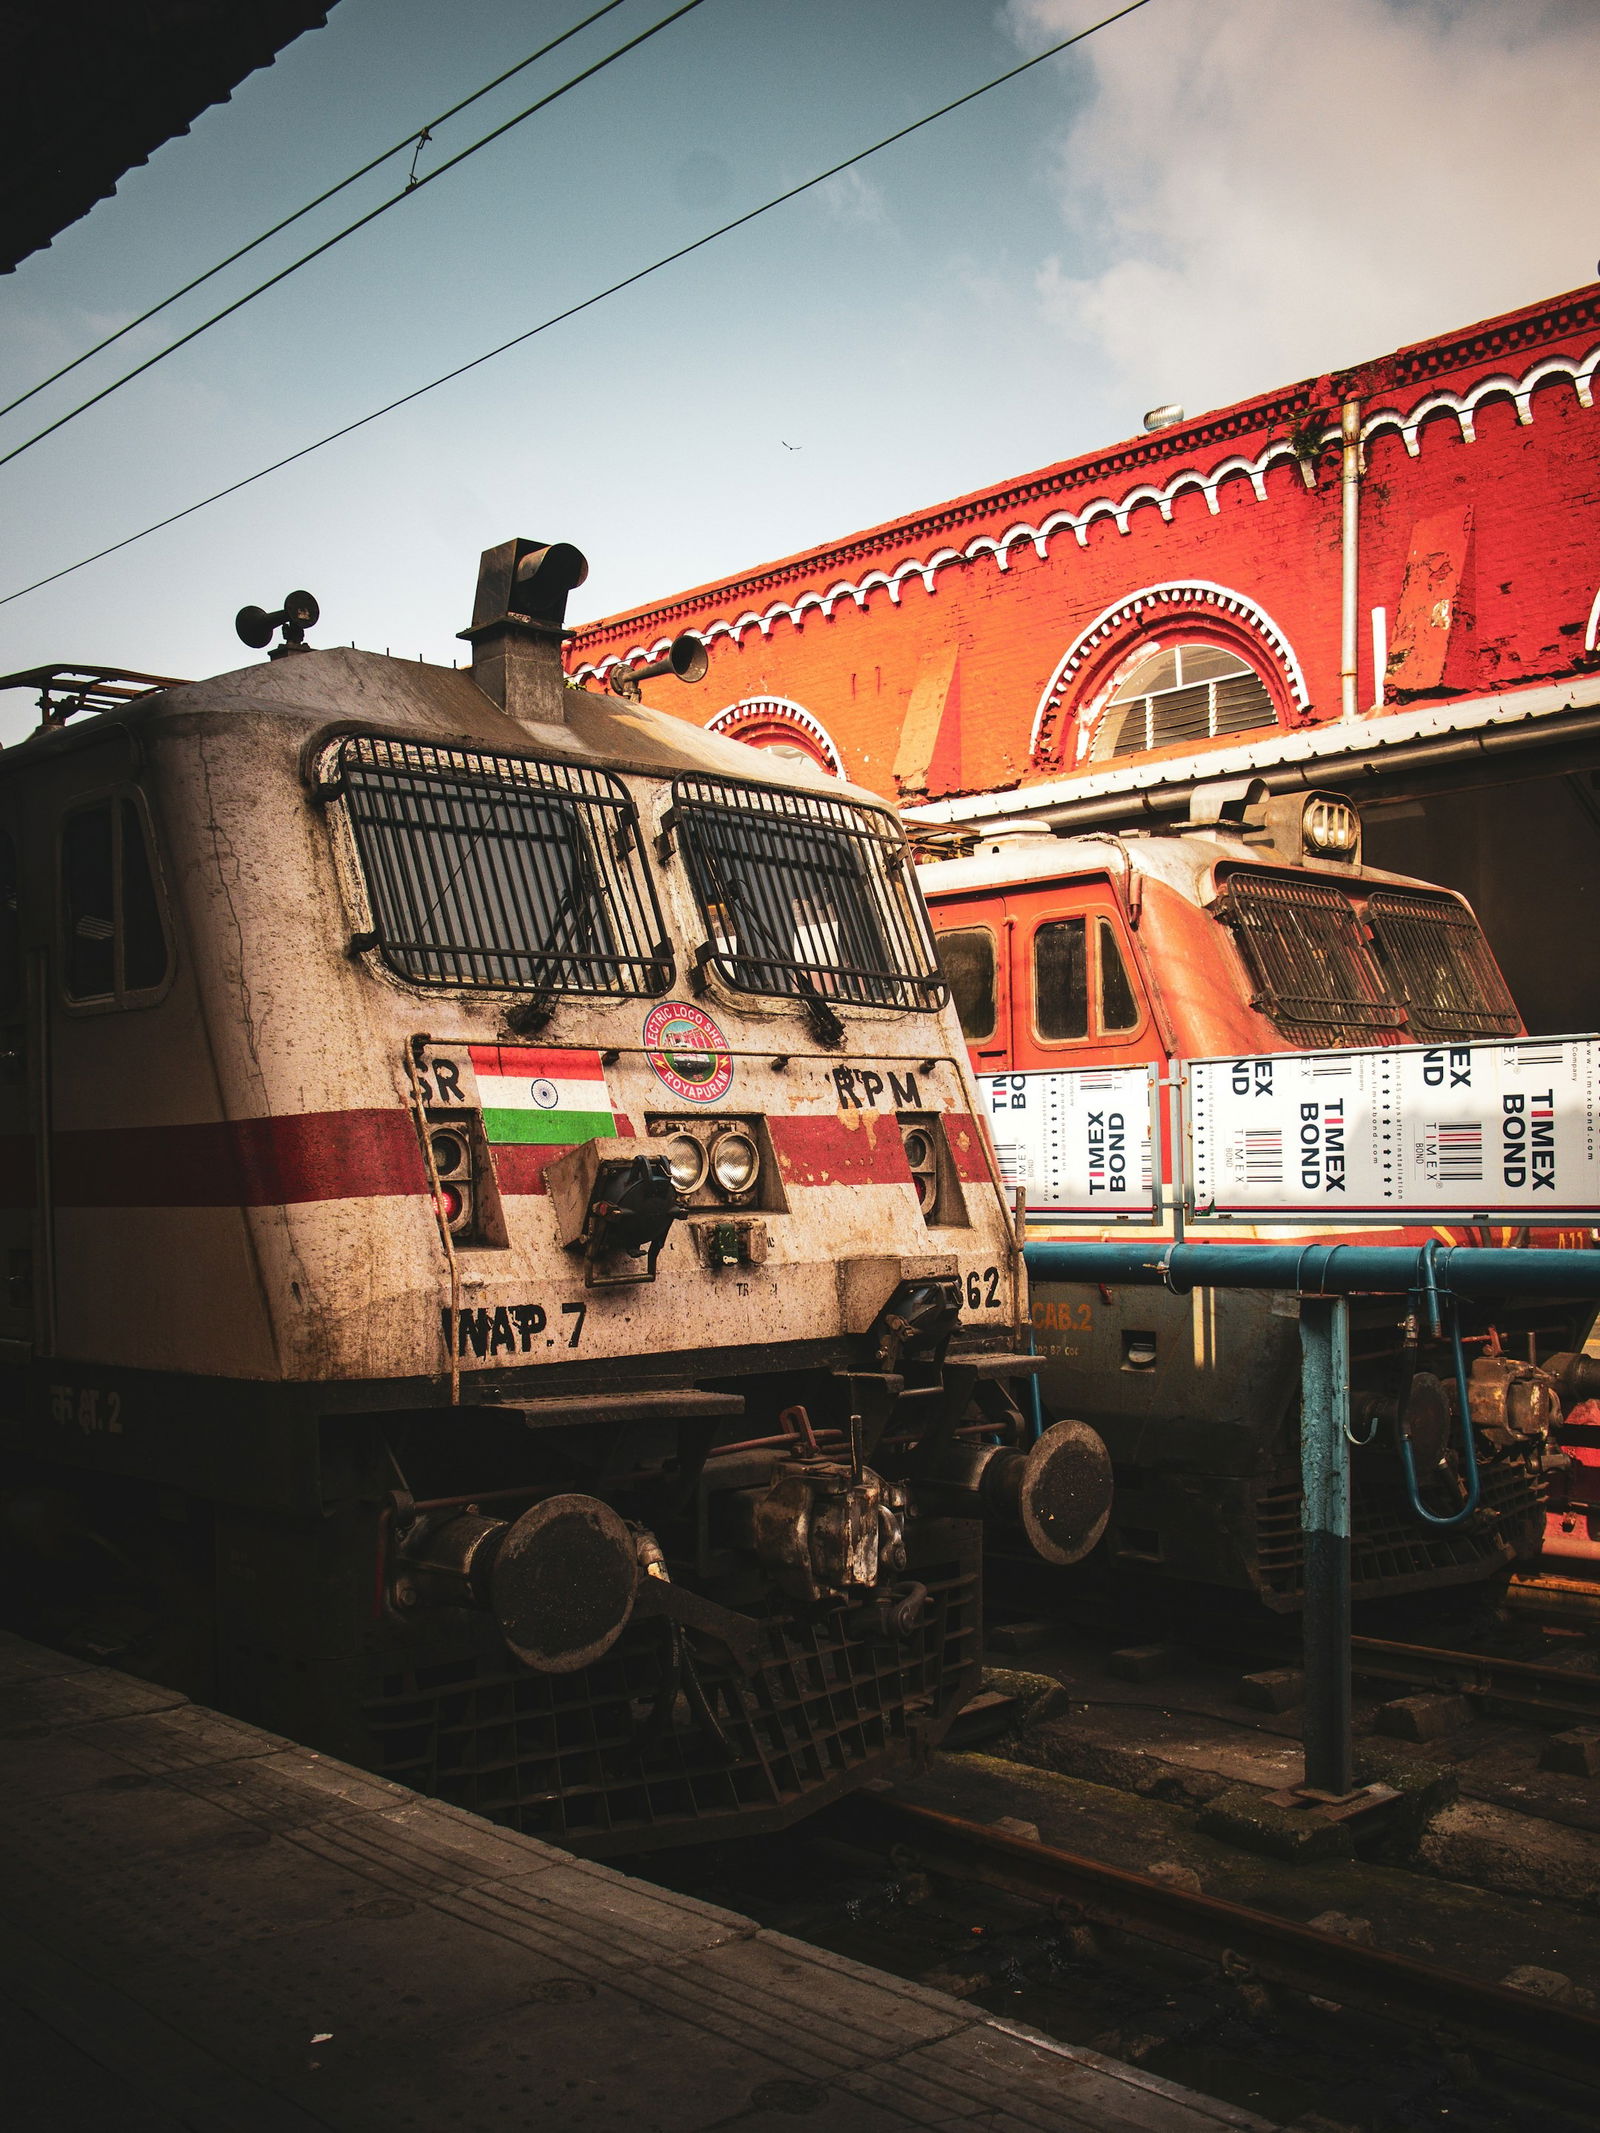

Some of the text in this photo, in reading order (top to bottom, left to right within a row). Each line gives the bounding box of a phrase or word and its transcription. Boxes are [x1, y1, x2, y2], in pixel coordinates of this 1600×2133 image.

[673, 1006, 703, 1024] LOCO
[664, 1070, 728, 1099] ROYAPURAM
[832, 1064, 922, 1109] RPM
[1394, 1095, 1402, 1116] days
[1586, 1041, 1594, 1161] www.timexbond.com
[1088, 1110, 1106, 1195] TIMEX
[1109, 1112, 1126, 1192] BOND
[1225, 1147, 1233, 1168] BOND
[1234, 1129, 1245, 1183] TIMEX
[1300, 1103, 1320, 1189] BOND
[1324, 1098, 1346, 1192] TIMEX
[1415, 1142, 1423, 1165] BOND
[1426, 1122, 1437, 1181] TIMEX
[1502, 1094, 1526, 1188] BOND
[1531, 1088, 1555, 1191] TIMEX
[1032, 1302, 1094, 1331] CAB.2
